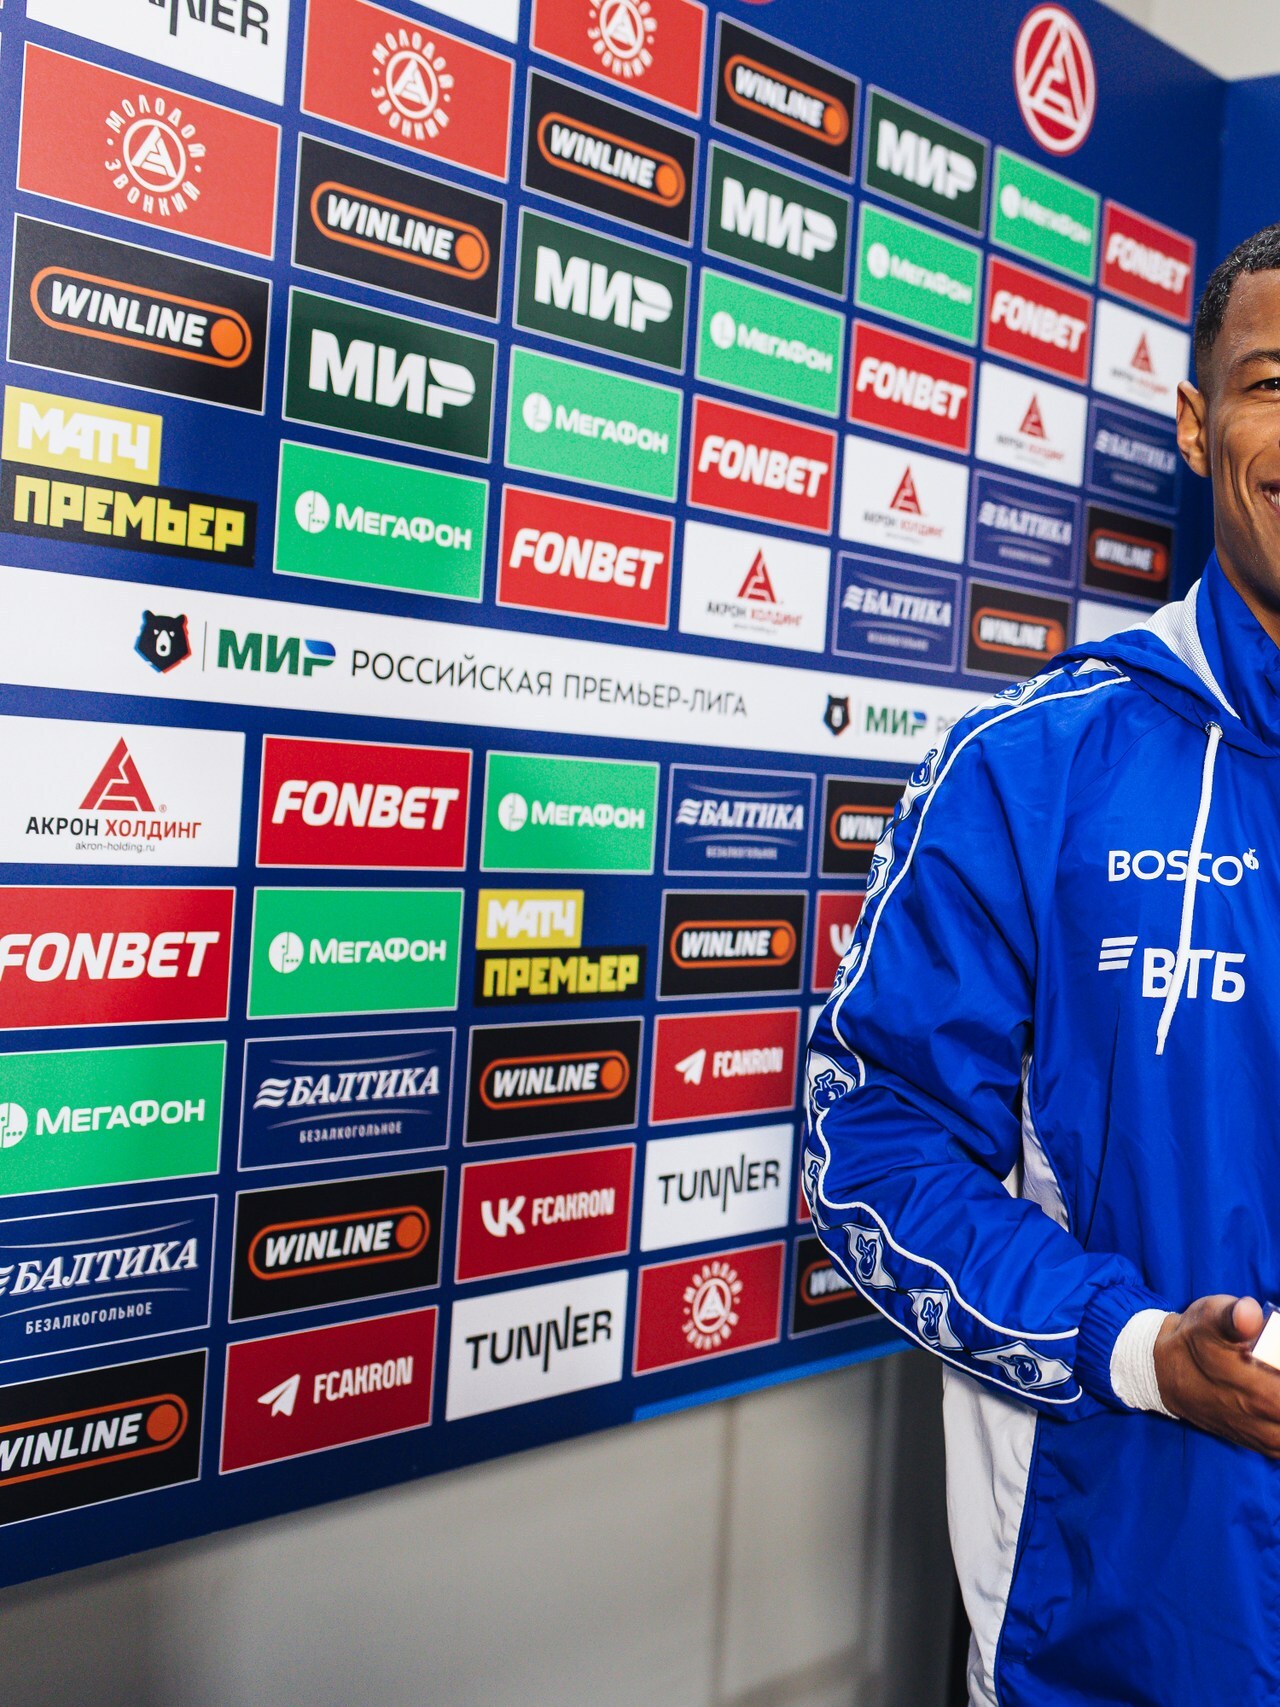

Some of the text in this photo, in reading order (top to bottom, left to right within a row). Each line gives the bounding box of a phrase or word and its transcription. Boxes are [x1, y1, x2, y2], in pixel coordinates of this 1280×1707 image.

[373, 28, 455, 103] МОЛОДОЙ
[736, 66, 824, 127] WINLINE
[105, 94, 207, 158] МОЛОДОЙ
[551, 125, 655, 188] WINLINE
[877, 119, 976, 199] МИР
[104, 157, 201, 217] ЗВОНКИЙ
[327, 194, 454, 263] WINLINE
[721, 177, 837, 260] МИР
[535, 246, 672, 332] МИР
[1105, 233, 1190, 293] FONBET
[52, 281, 207, 347] WINLINE
[991, 291, 1088, 352] FONBET
[309, 329, 475, 418] МИР
[857, 357, 967, 419] FONBET
[17, 401, 150, 470] МАТЧ
[698, 435, 828, 497] FONBET
[14, 475, 244, 551] ПРЕМЬЕР
[510, 528, 664, 589] FONBET
[860, 584, 952, 628] БАЛТИКА
[218, 629, 747, 716] МИР РОССИЙСКАЯ ПРЕМЬЕР-ЛИГА
[866, 706, 927, 736] МИР
[26, 817, 201, 840] АКРОН ХОЛДИНГ
[272, 780, 459, 830] FONBET
[698, 796, 804, 831] БАЛТИКА
[75, 841, 155, 854] akron-holding.ru
[1107, 848, 1244, 887] BOSCO
[487, 900, 576, 938] МАТЧ
[682, 930, 770, 958] WINLINE
[0, 932, 219, 982] FONBET
[483, 955, 639, 996] ПРЕМЬЕР
[1141, 946, 1247, 1003] ВТБ
[287, 1065, 440, 1107] БАЛТИКА
[494, 1063, 599, 1098] WINLINE
[713, 1047, 783, 1077] FCAKRON
[298, 1120, 403, 1144] БЕЗАЛКОГОЛЬНОЕ
[532, 1188, 615, 1226] FCAKRON
[658, 1154, 780, 1212] TUNNER
[9, 1238, 199, 1296] БАЛТИКА
[266, 1221, 393, 1267] WINLINE
[25, 1301, 154, 1335] БЕЗАЛКОГОЛЬНОЕ
[465, 1306, 611, 1373] TUNNER
[313, 1356, 413, 1404] FCAKRON
